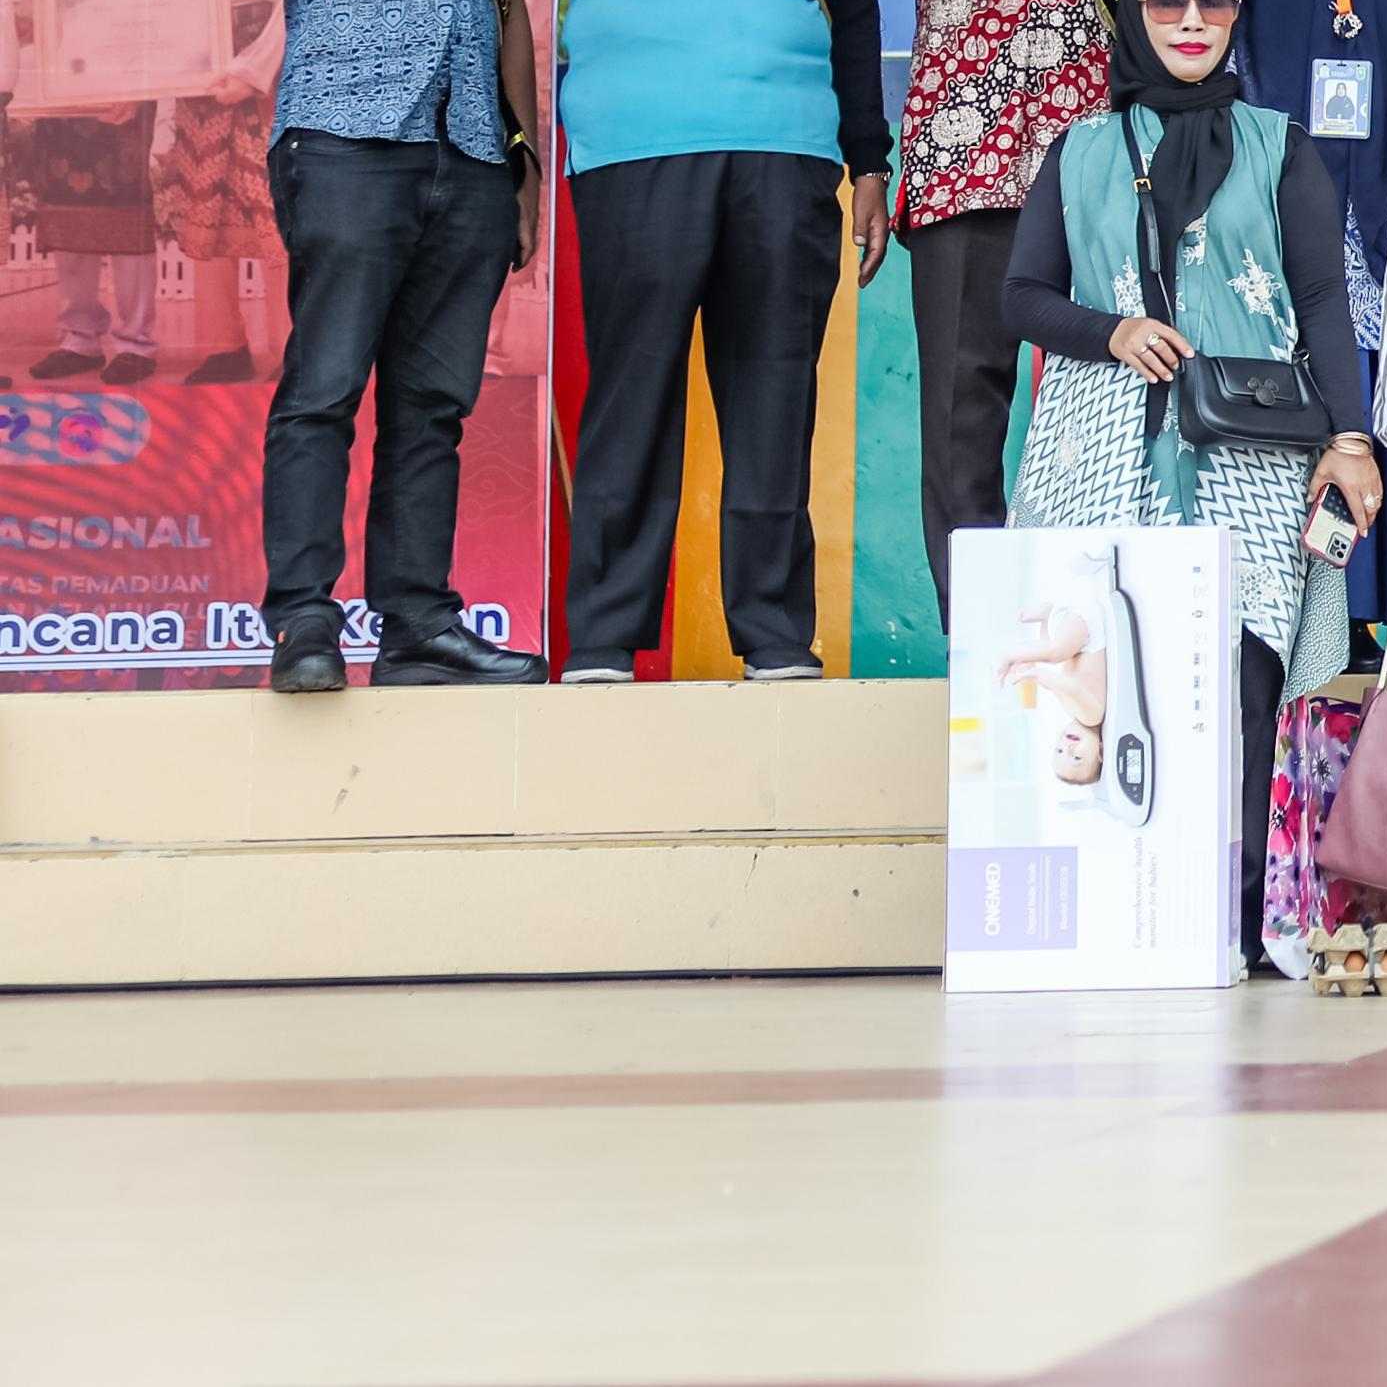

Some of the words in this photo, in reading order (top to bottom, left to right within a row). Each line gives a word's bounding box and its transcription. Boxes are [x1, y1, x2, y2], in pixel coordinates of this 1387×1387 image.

[0, 514, 212, 550] ASIONAL
[0, 615, 179, 649] ncana
[212, 607, 262, 643] It
[984, 862, 1001, 935] ONEMED
